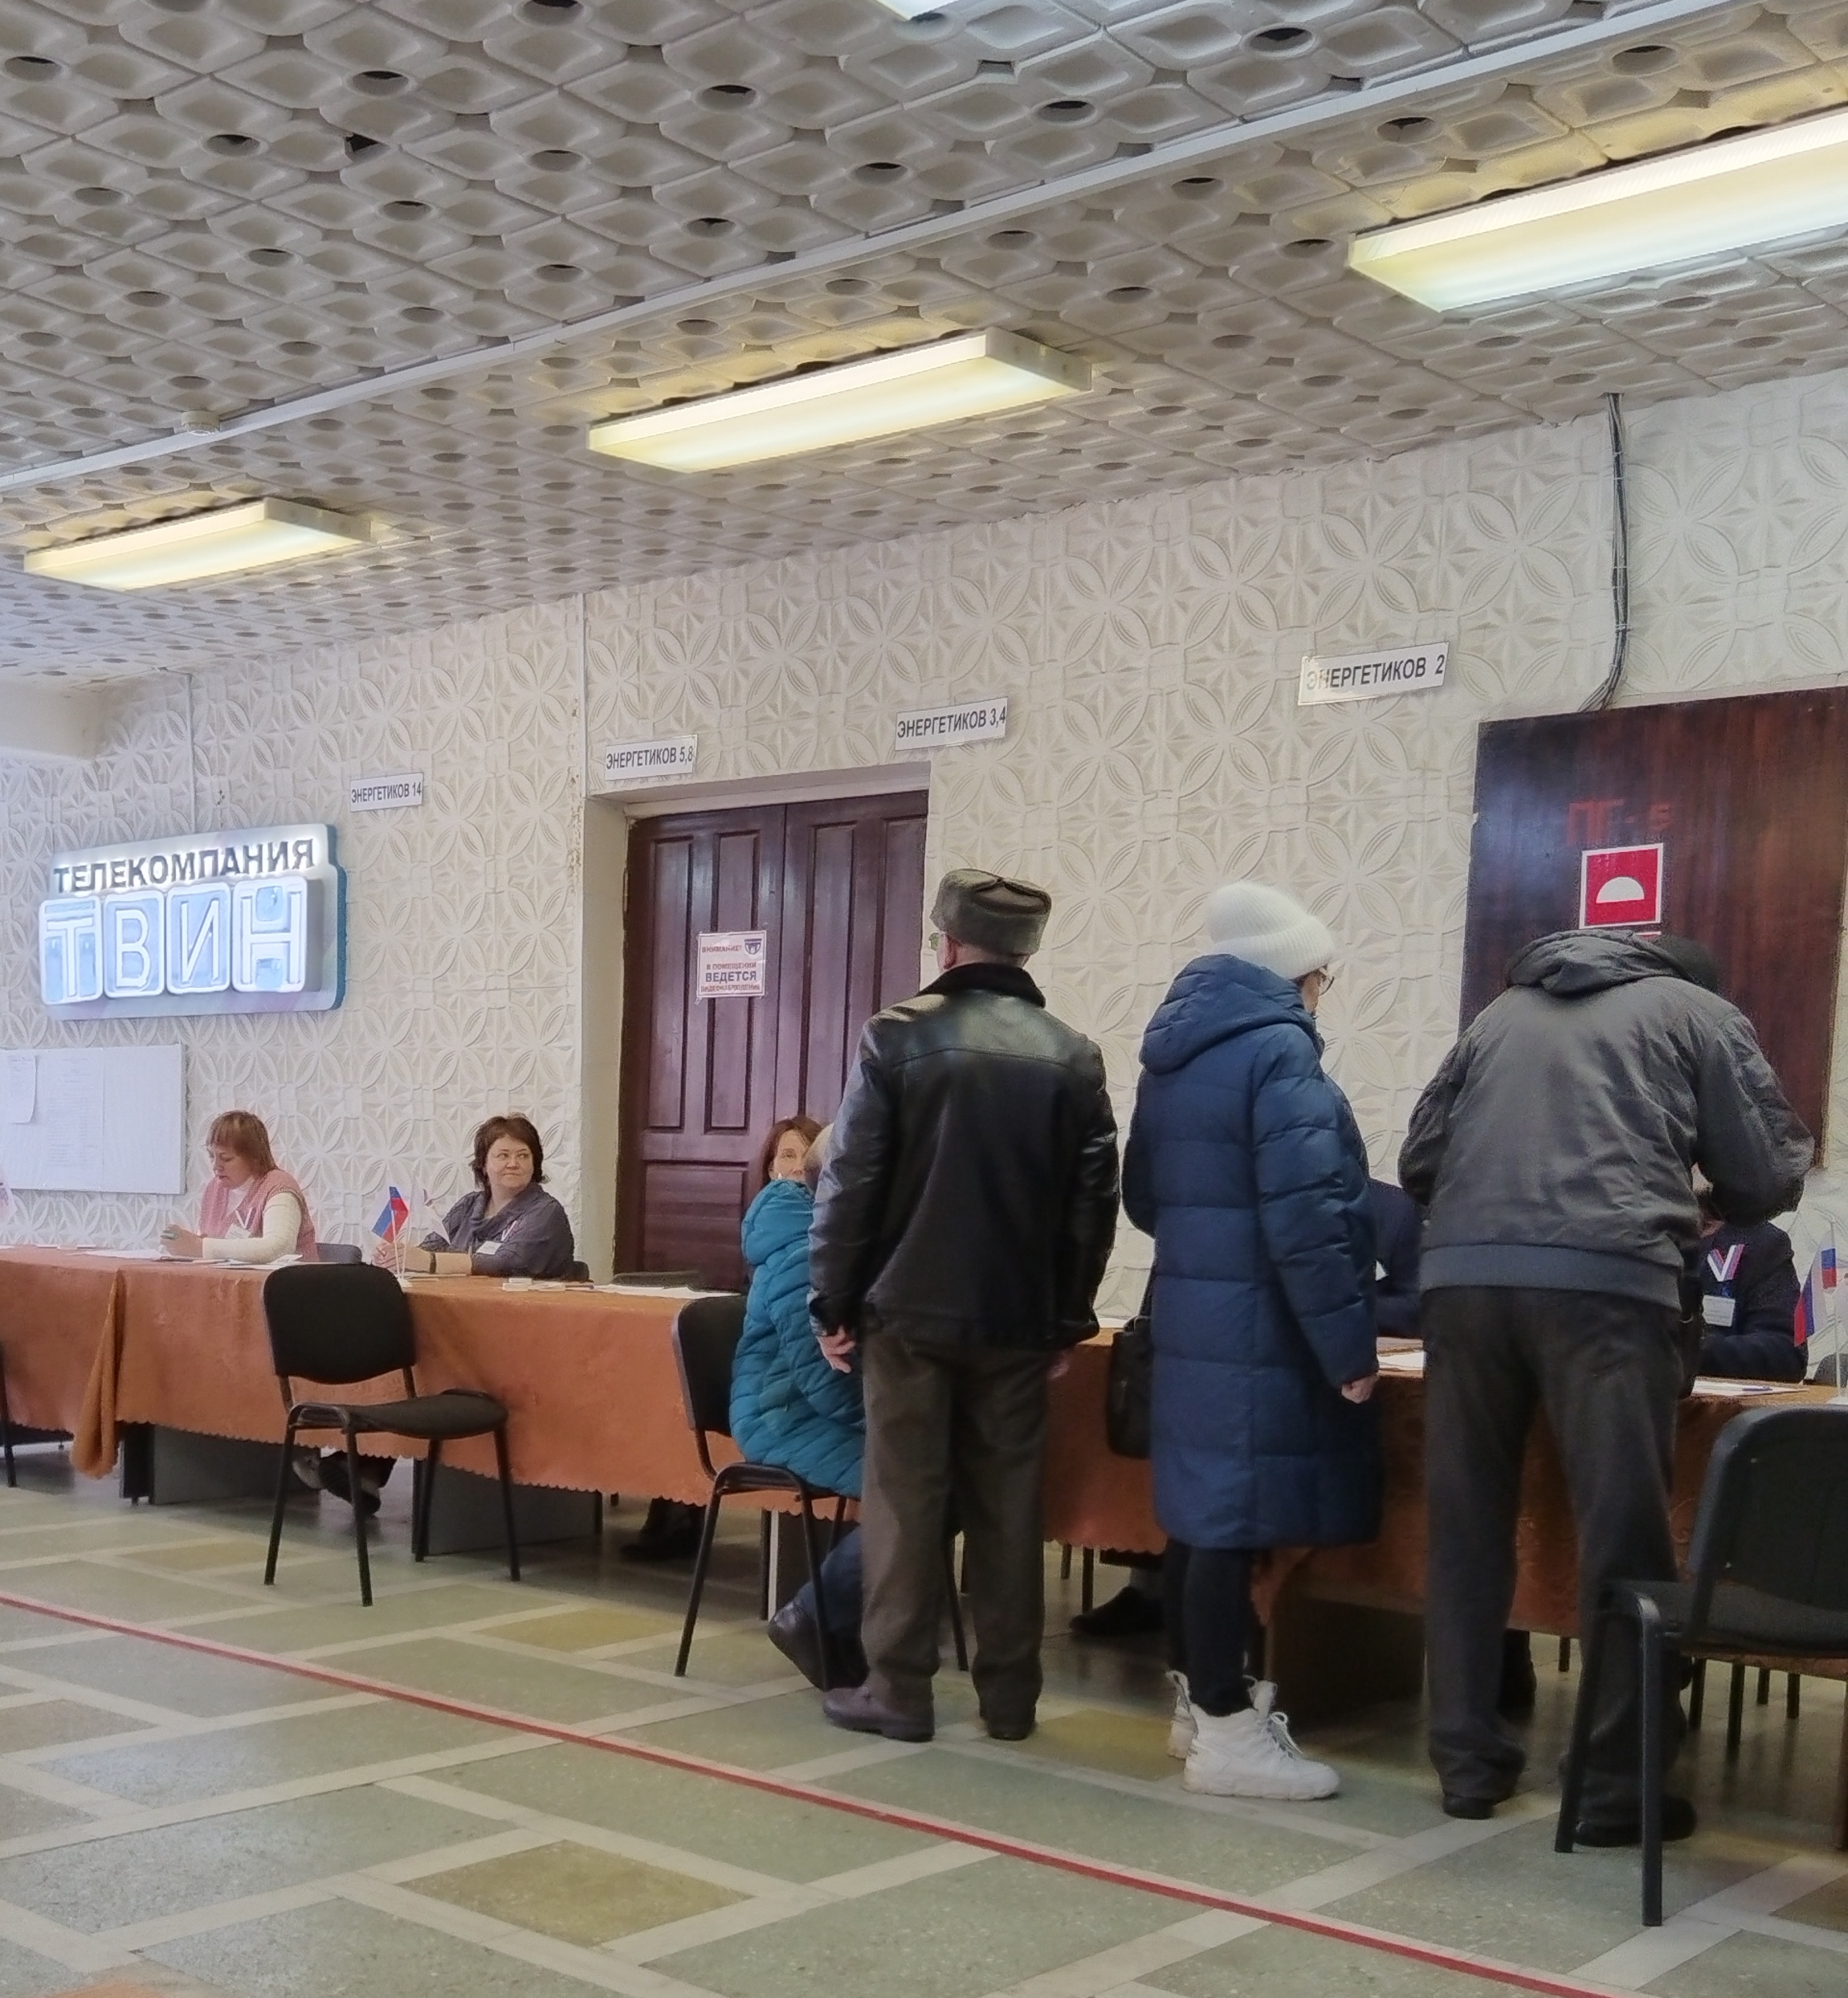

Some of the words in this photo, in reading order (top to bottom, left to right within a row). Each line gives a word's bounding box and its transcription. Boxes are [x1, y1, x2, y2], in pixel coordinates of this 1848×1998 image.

[1306, 657, 1426, 691] ЭНЕРГЕТИКОВ
[1434, 654, 1445, 675] 2
[897, 709, 986, 738] ЭНЕРГЕТИКОВ
[989, 706, 1006, 728] 3,4
[606, 747, 677, 769] ЭНЕРГЕТИКОВ
[679, 745, 693, 765] 5,8
[351, 783, 410, 804] ЭНЕРГЕТИКОВ
[412, 781, 422, 797] 14
[53, 838, 316, 894] ТЕЛЕКОМПАНИЯ
[44, 887, 304, 998] ТВИН
[705, 970, 757, 984] ВЕДЕТСЯ
